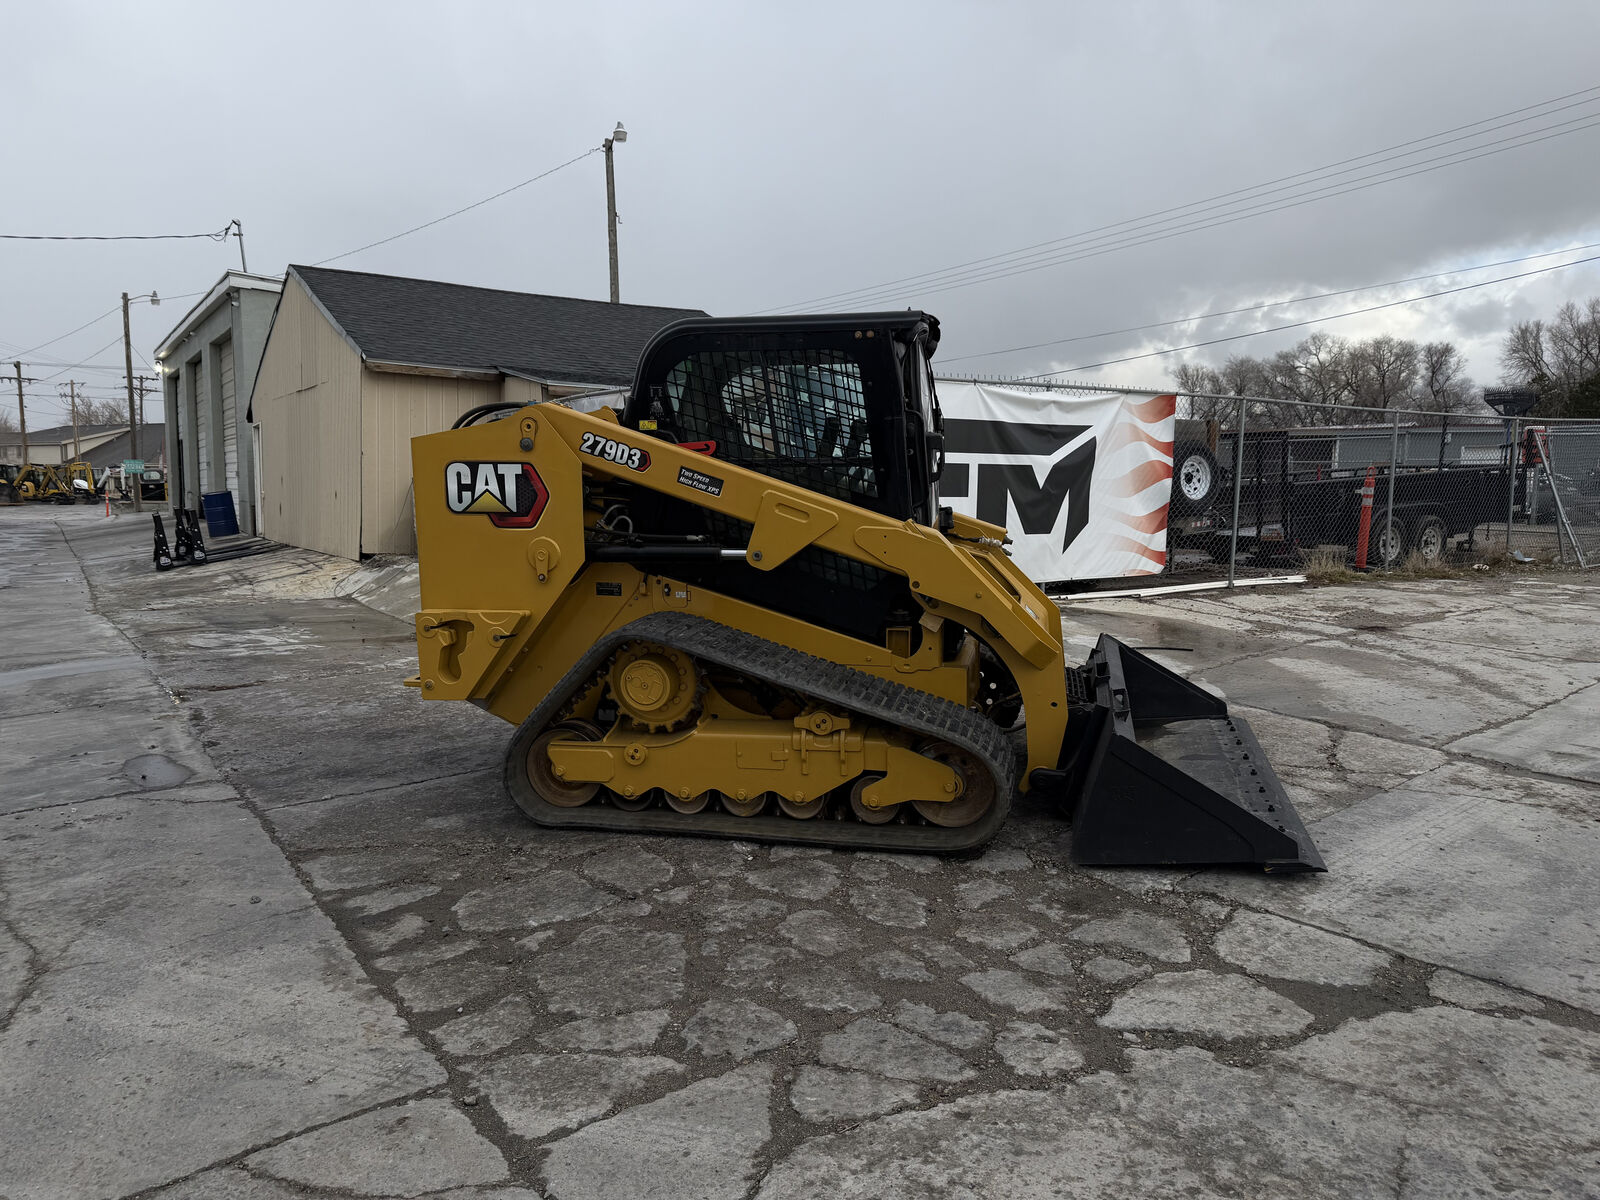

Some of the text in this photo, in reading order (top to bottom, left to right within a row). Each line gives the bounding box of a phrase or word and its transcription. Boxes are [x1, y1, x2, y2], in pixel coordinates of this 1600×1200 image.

[580, 432, 641, 469] 279D3
[446, 462, 522, 513] CAT
[707, 486, 719, 494] XPS
